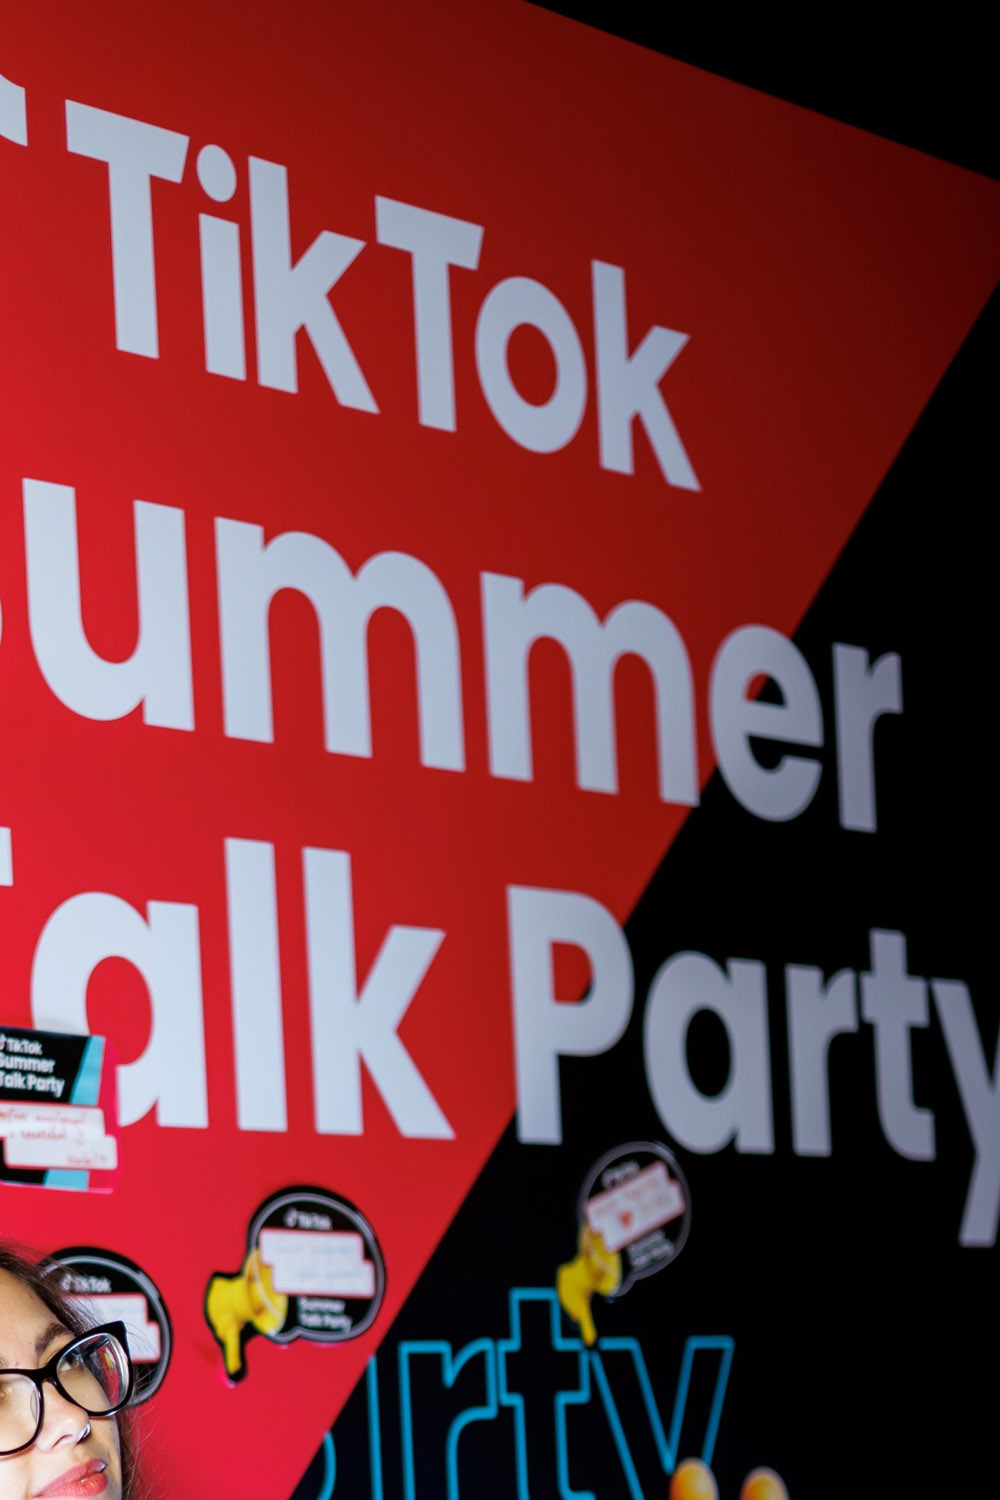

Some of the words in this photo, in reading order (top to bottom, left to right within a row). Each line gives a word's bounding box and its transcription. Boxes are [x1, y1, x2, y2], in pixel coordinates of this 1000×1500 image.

[64, 98, 701, 492] TikTok
[6, 1038, 43, 1056] TikTok
[26, 1073, 66, 1098] Party
[506, 884, 1000, 1246] Party
